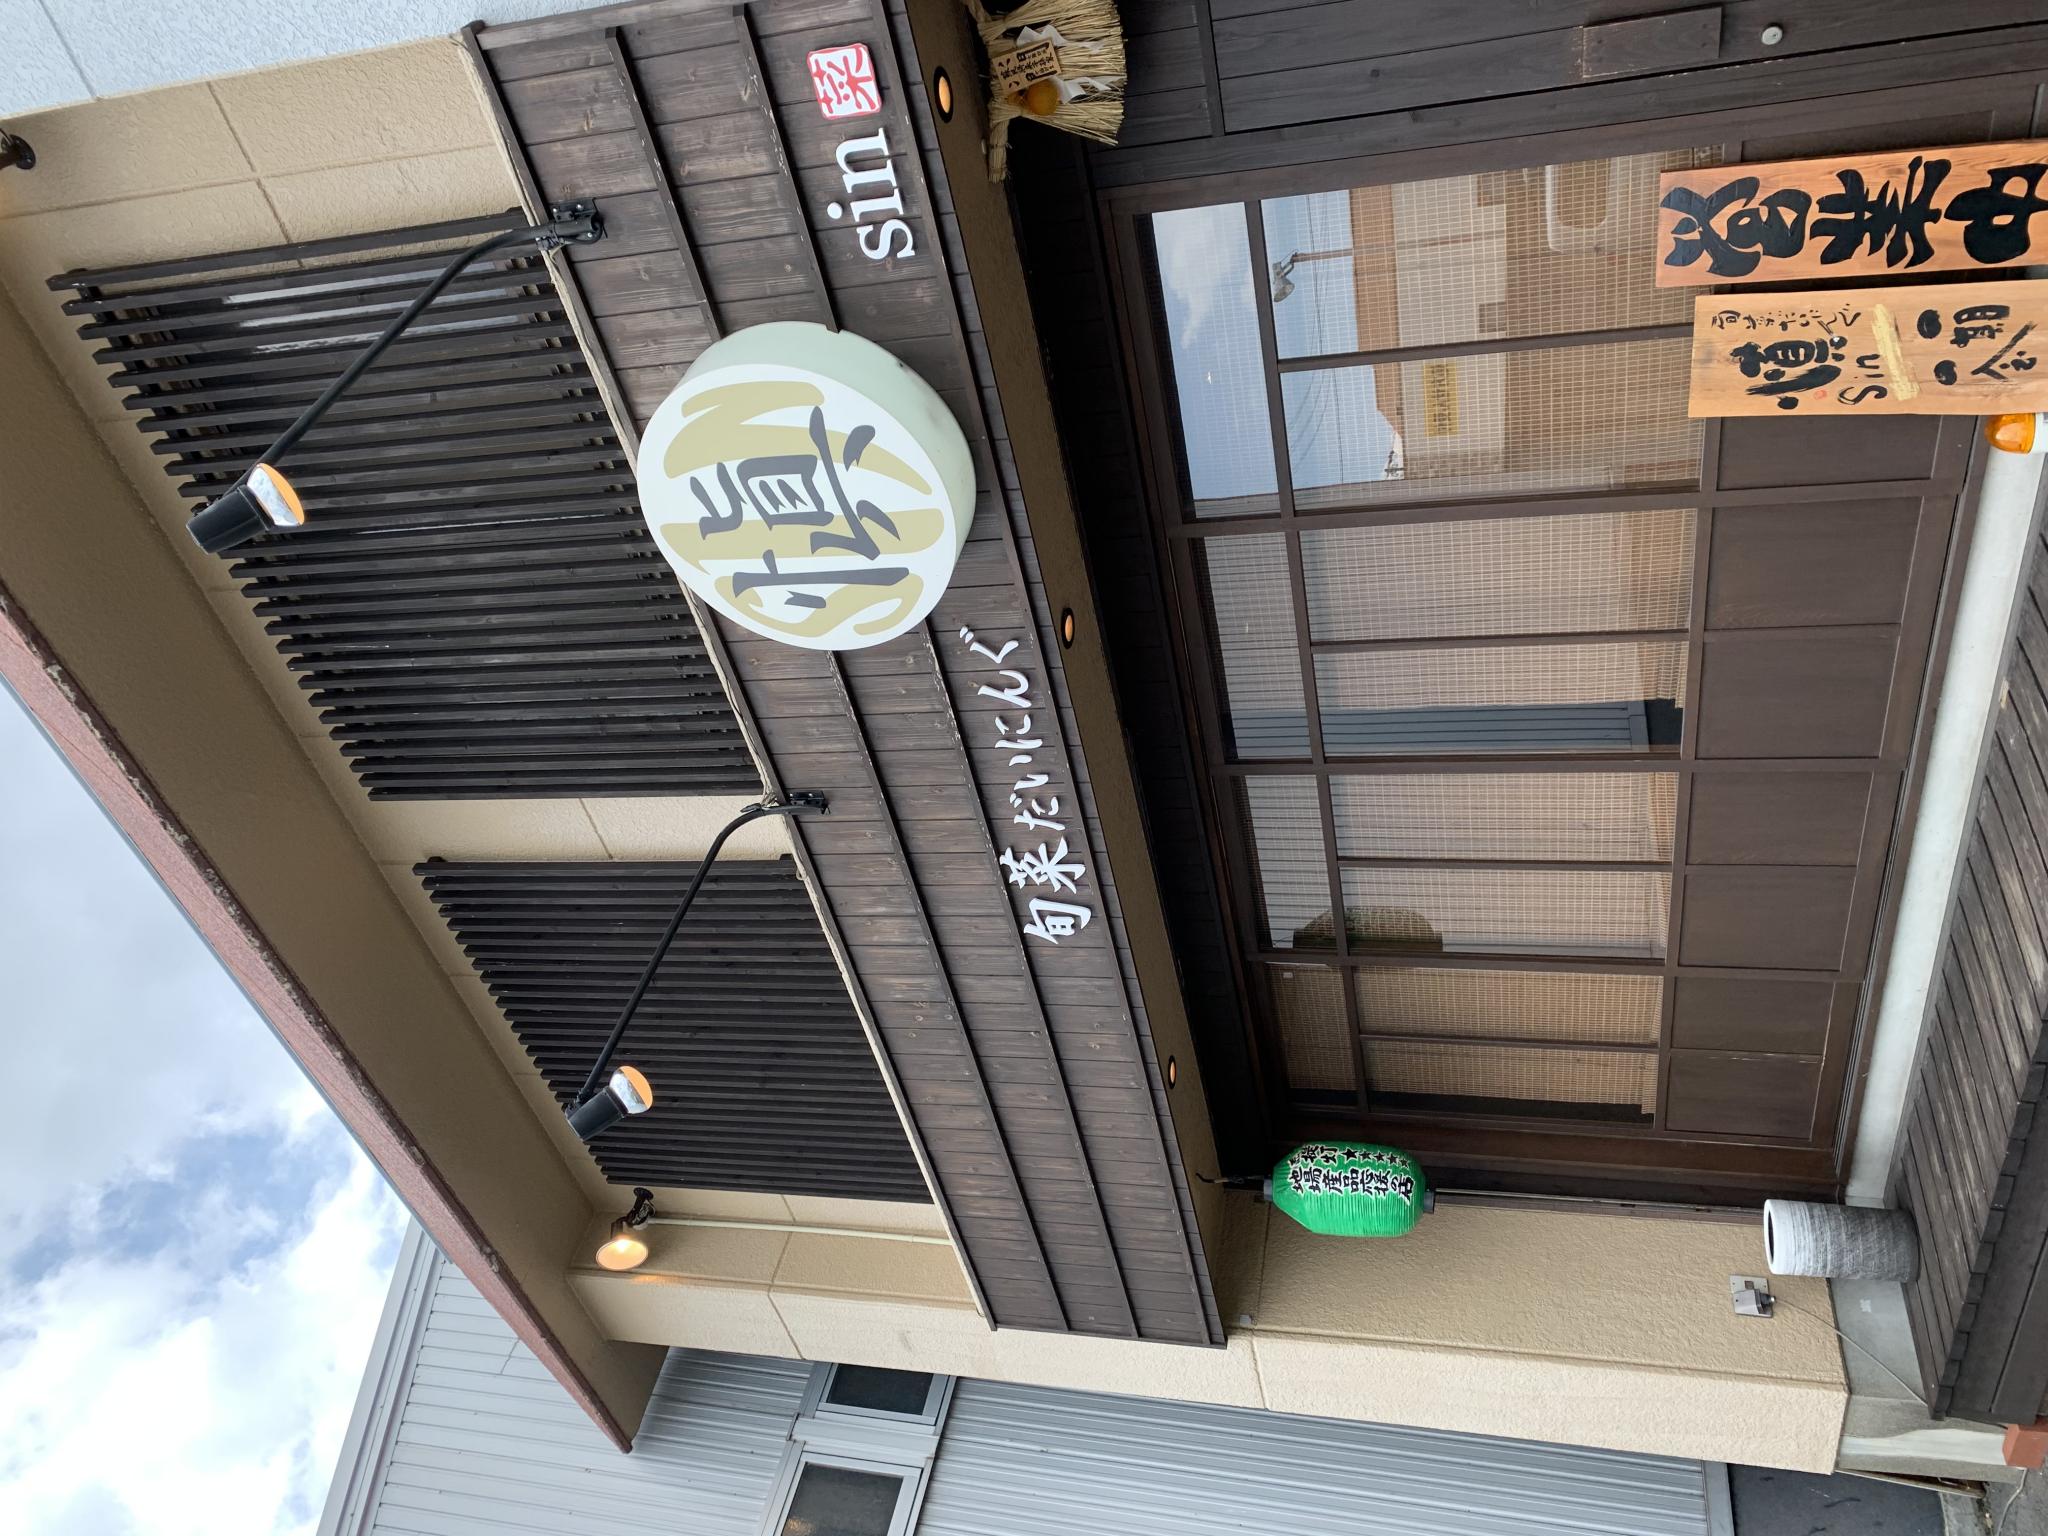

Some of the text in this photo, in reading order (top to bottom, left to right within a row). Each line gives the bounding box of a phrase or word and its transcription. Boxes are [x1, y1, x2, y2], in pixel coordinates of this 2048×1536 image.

[811, 45, 878, 115] 菜
[827, 128, 916, 260] sin
[1660, 156, 2048, 277] 営業中
[1837, 353, 1888, 405] Sin
[960, 626, 1092, 945] 旬菜だいにんぐ
[1288, 1166, 1415, 1206] 地場産品応援の店
